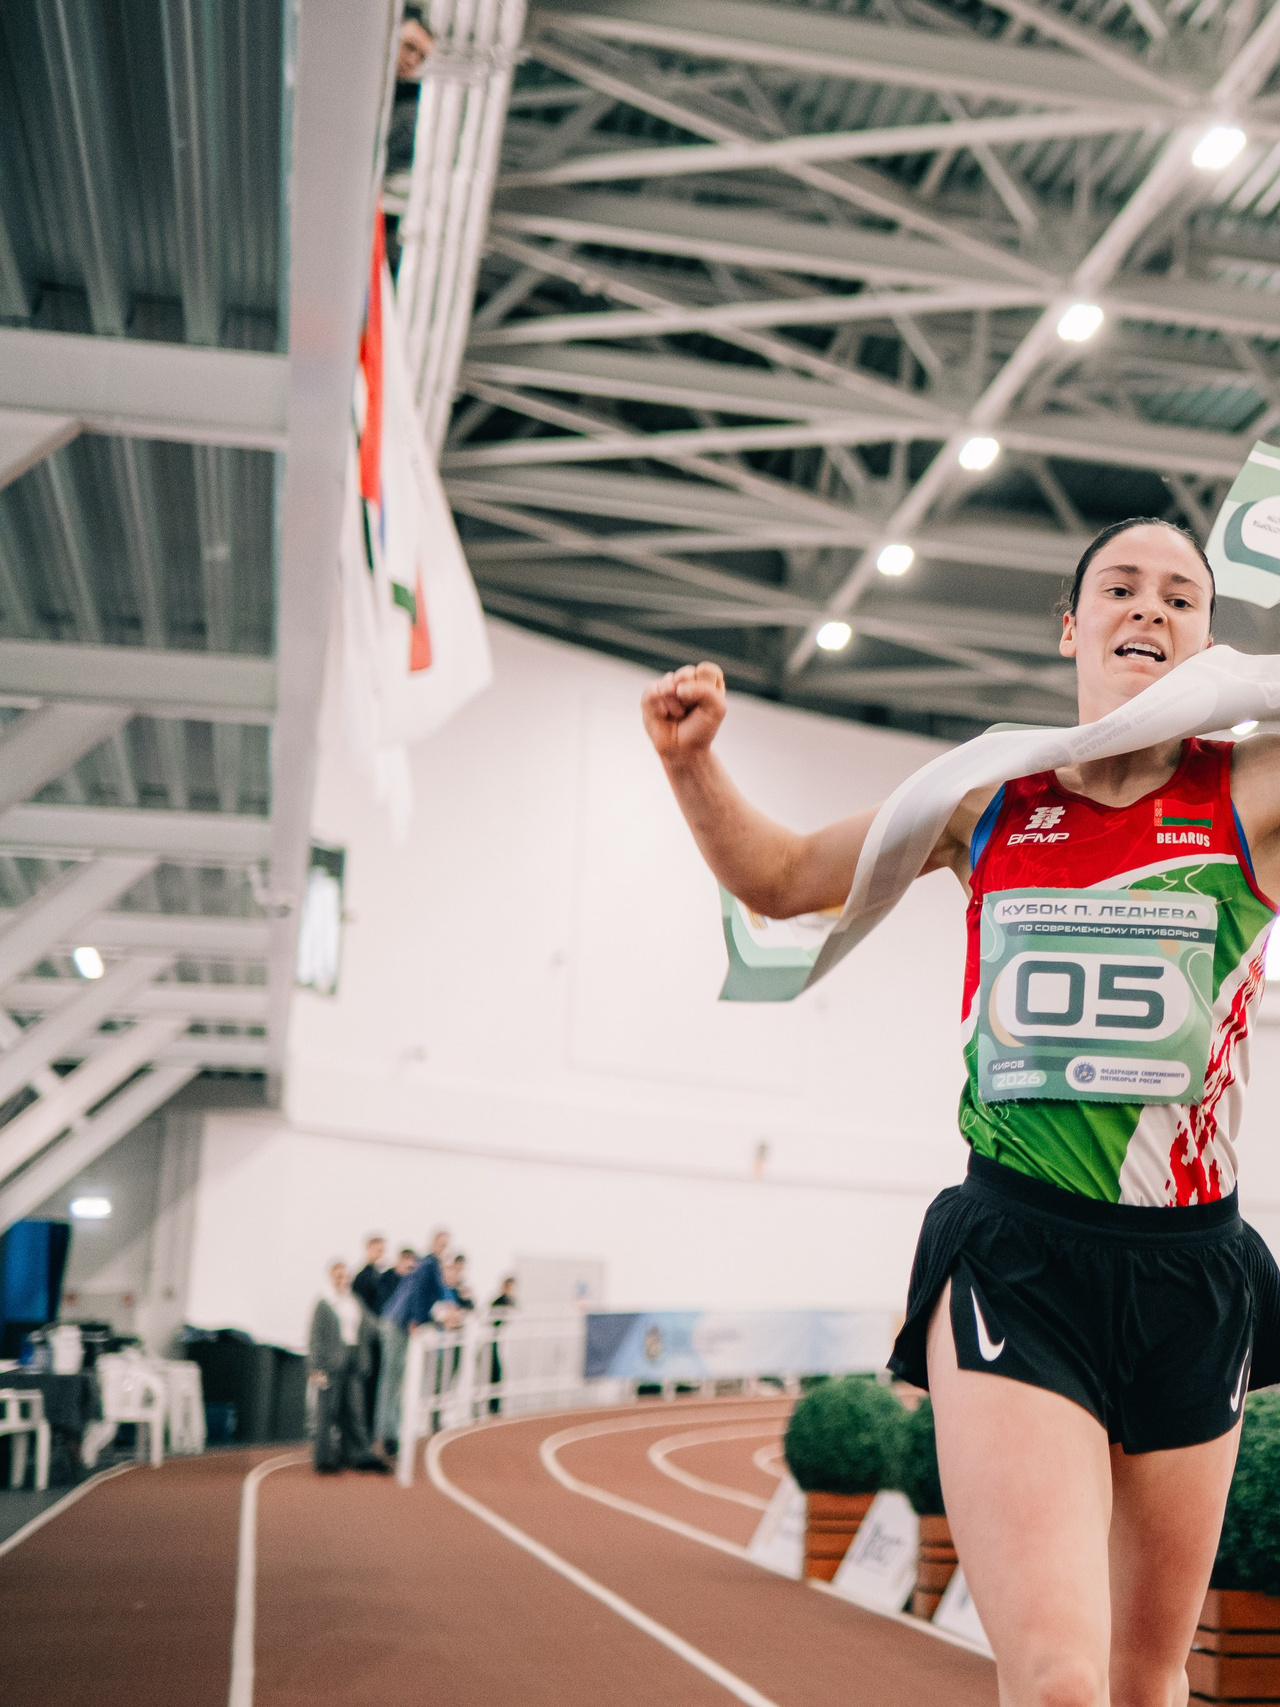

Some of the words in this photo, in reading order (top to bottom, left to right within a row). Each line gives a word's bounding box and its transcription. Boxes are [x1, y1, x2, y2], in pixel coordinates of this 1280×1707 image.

[1007, 832, 1069, 846] BFMP
[1156, 832, 1210, 847] BELARUS
[1002, 904, 1067, 917] КУБОК
[1074, 905, 1092, 916] П.
[1098, 905, 1197, 920] ЛЕДНЕВА
[1018, 924, 1033, 932] ПО
[1034, 925, 1128, 935] СОВРЕМЕННОМУ
[1129, 928, 1199, 939] ПЯТИБОРЬЮ
[1015, 960, 1165, 1030] 05
[992, 1060, 1025, 1071] КИРОВ
[996, 1072, 1041, 1088] 2026
